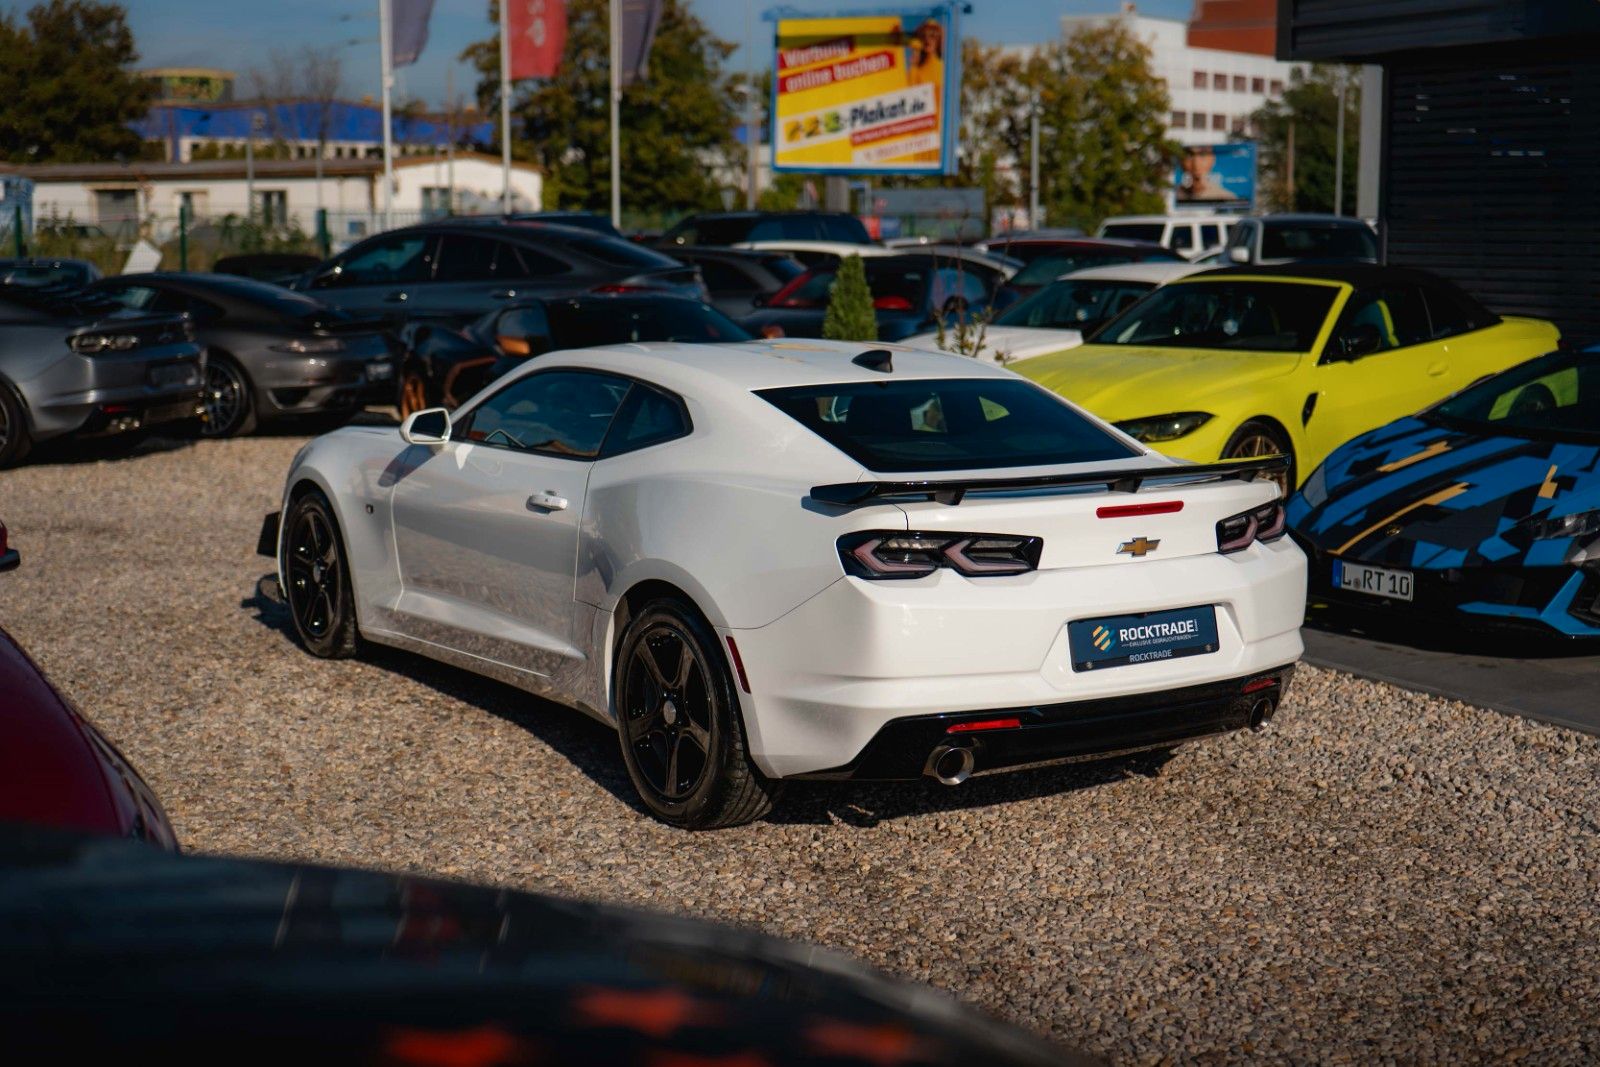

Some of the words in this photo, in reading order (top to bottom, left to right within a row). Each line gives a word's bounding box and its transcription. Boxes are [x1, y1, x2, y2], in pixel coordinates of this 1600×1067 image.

[785, 67, 833, 93] online
[833, 53, 889, 81] buchen
[1342, 565, 1352, 586] L
[1363, 569, 1385, 591] RT
[1388, 574, 1410, 596] 10
[1119, 619, 1195, 642] ROCKTRADE
[1129, 649, 1173, 663] ROCKTRADE
